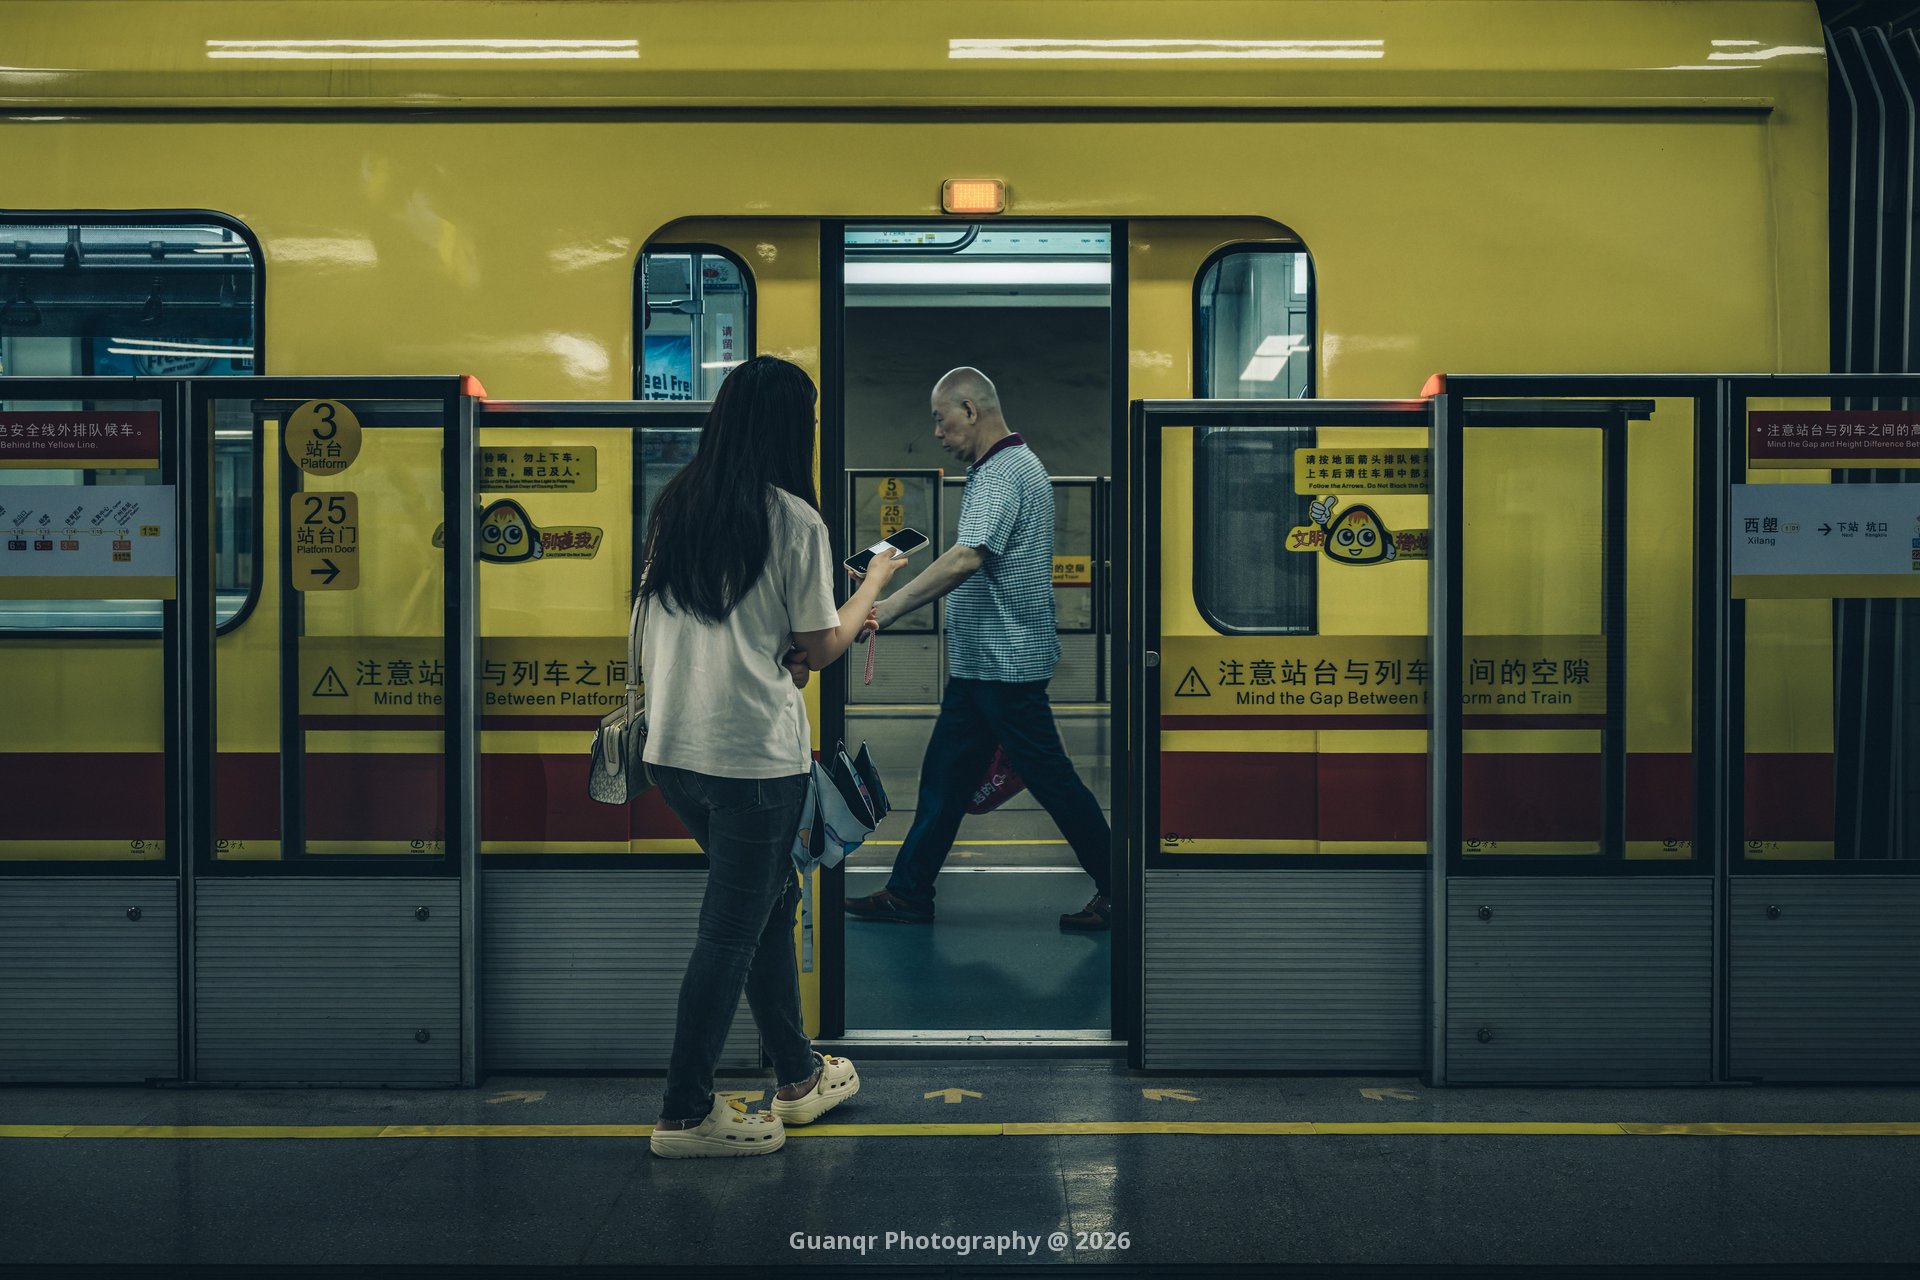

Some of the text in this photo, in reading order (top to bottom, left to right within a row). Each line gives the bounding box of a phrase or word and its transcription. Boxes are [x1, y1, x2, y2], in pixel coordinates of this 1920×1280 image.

[671, 375, 692, 393] Fre
[312, 403, 337, 440] 3
[0, 441, 98, 449] Behind the Yellow Line.
[306, 440, 342, 457] 站台
[1802, 441, 1818, 449] Gap
[1837, 441, 1862, 449] Height
[301, 458, 347, 468] Platform
[888, 478, 896, 491] 5
[304, 496, 346, 524] 25
[885, 505, 899, 516] 25
[1744, 517, 1778, 533] 西塱
[1837, 522, 1887, 532] 下站 坑口
[297, 526, 356, 544] 站台门
[1292, 530, 1324, 548] 文明
[1748, 537, 1776, 546] Xilang
[297, 545, 356, 553] Platform Door
[374, 692, 413, 705] Mind
[417, 692, 442, 705] the
[486, 692, 556, 705] Between
[1236, 691, 1275, 705] Mind
[1279, 691, 1305, 705] the
[1309, 691, 1343, 708] Gap
[1348, 691, 1418, 705] Between
[1497, 692, 1526, 705] and
[1531, 691, 1572, 705] Train
